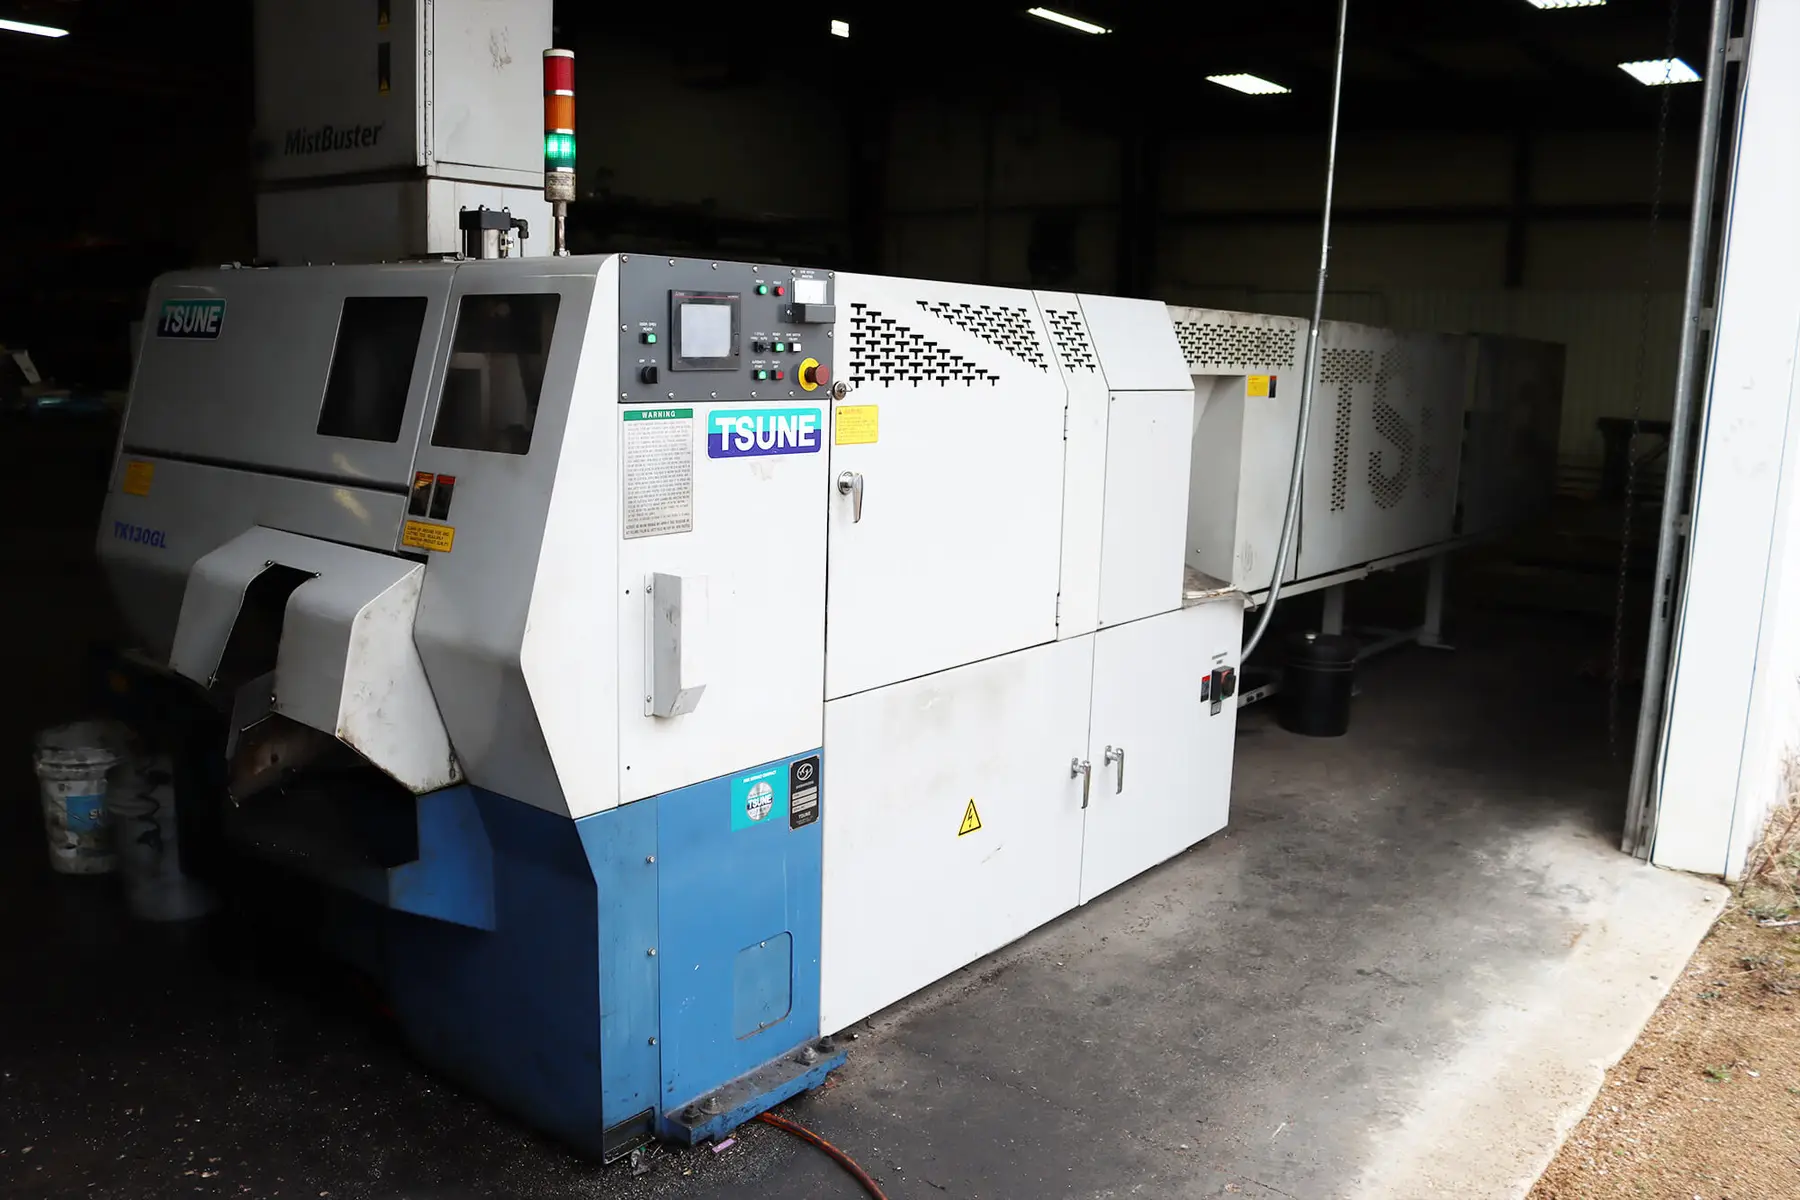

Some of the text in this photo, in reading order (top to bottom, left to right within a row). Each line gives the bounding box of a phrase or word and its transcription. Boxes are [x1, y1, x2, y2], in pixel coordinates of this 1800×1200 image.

[284, 123, 382, 156] MistBuster
[164, 304, 222, 334] TSUNE
[641, 410, 677, 419] WARNING
[715, 413, 816, 452] TSUNE
[113, 520, 166, 549] TK130GL
